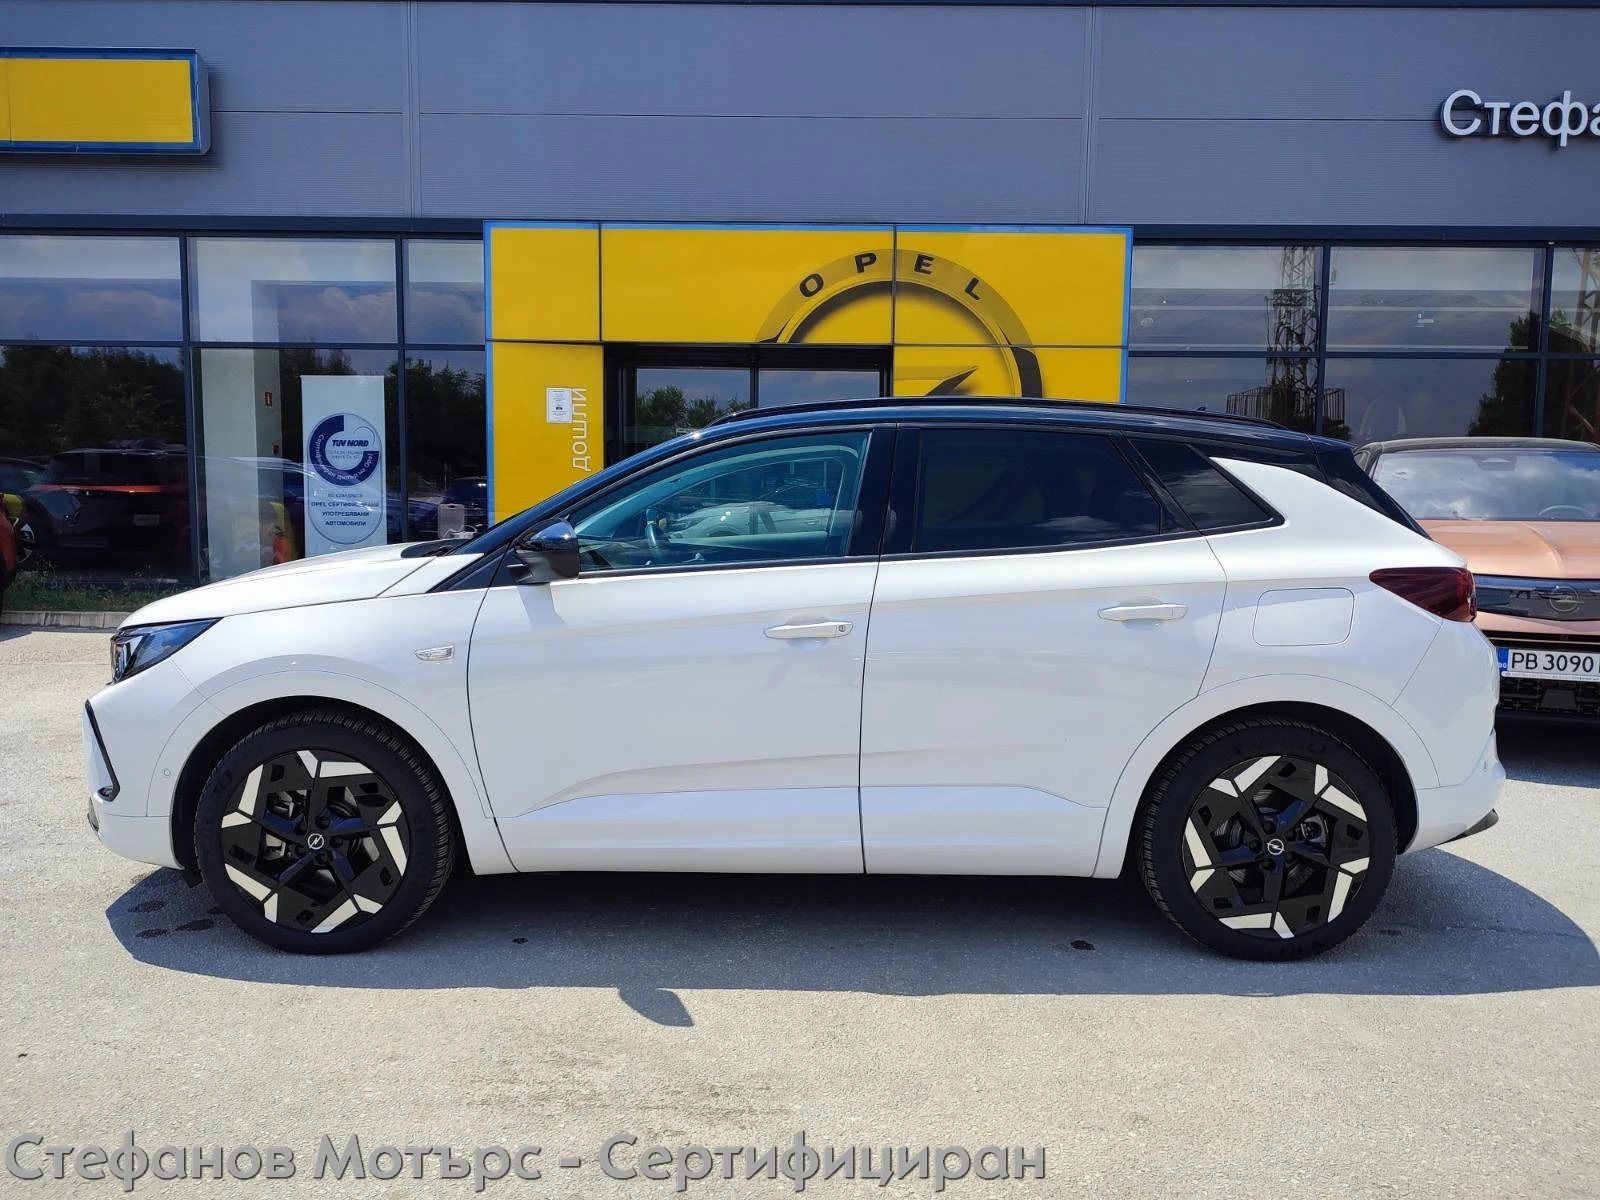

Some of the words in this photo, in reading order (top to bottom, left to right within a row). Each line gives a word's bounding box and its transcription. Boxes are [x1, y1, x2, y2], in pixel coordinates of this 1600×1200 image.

[799, 252, 982, 300] OPEL
[347, 439, 369, 447] NORD
[572, 388, 591, 472] ДОШЛИ
[1511, 652, 1538, 670] PB
[1542, 654, 1594, 673] 3090
